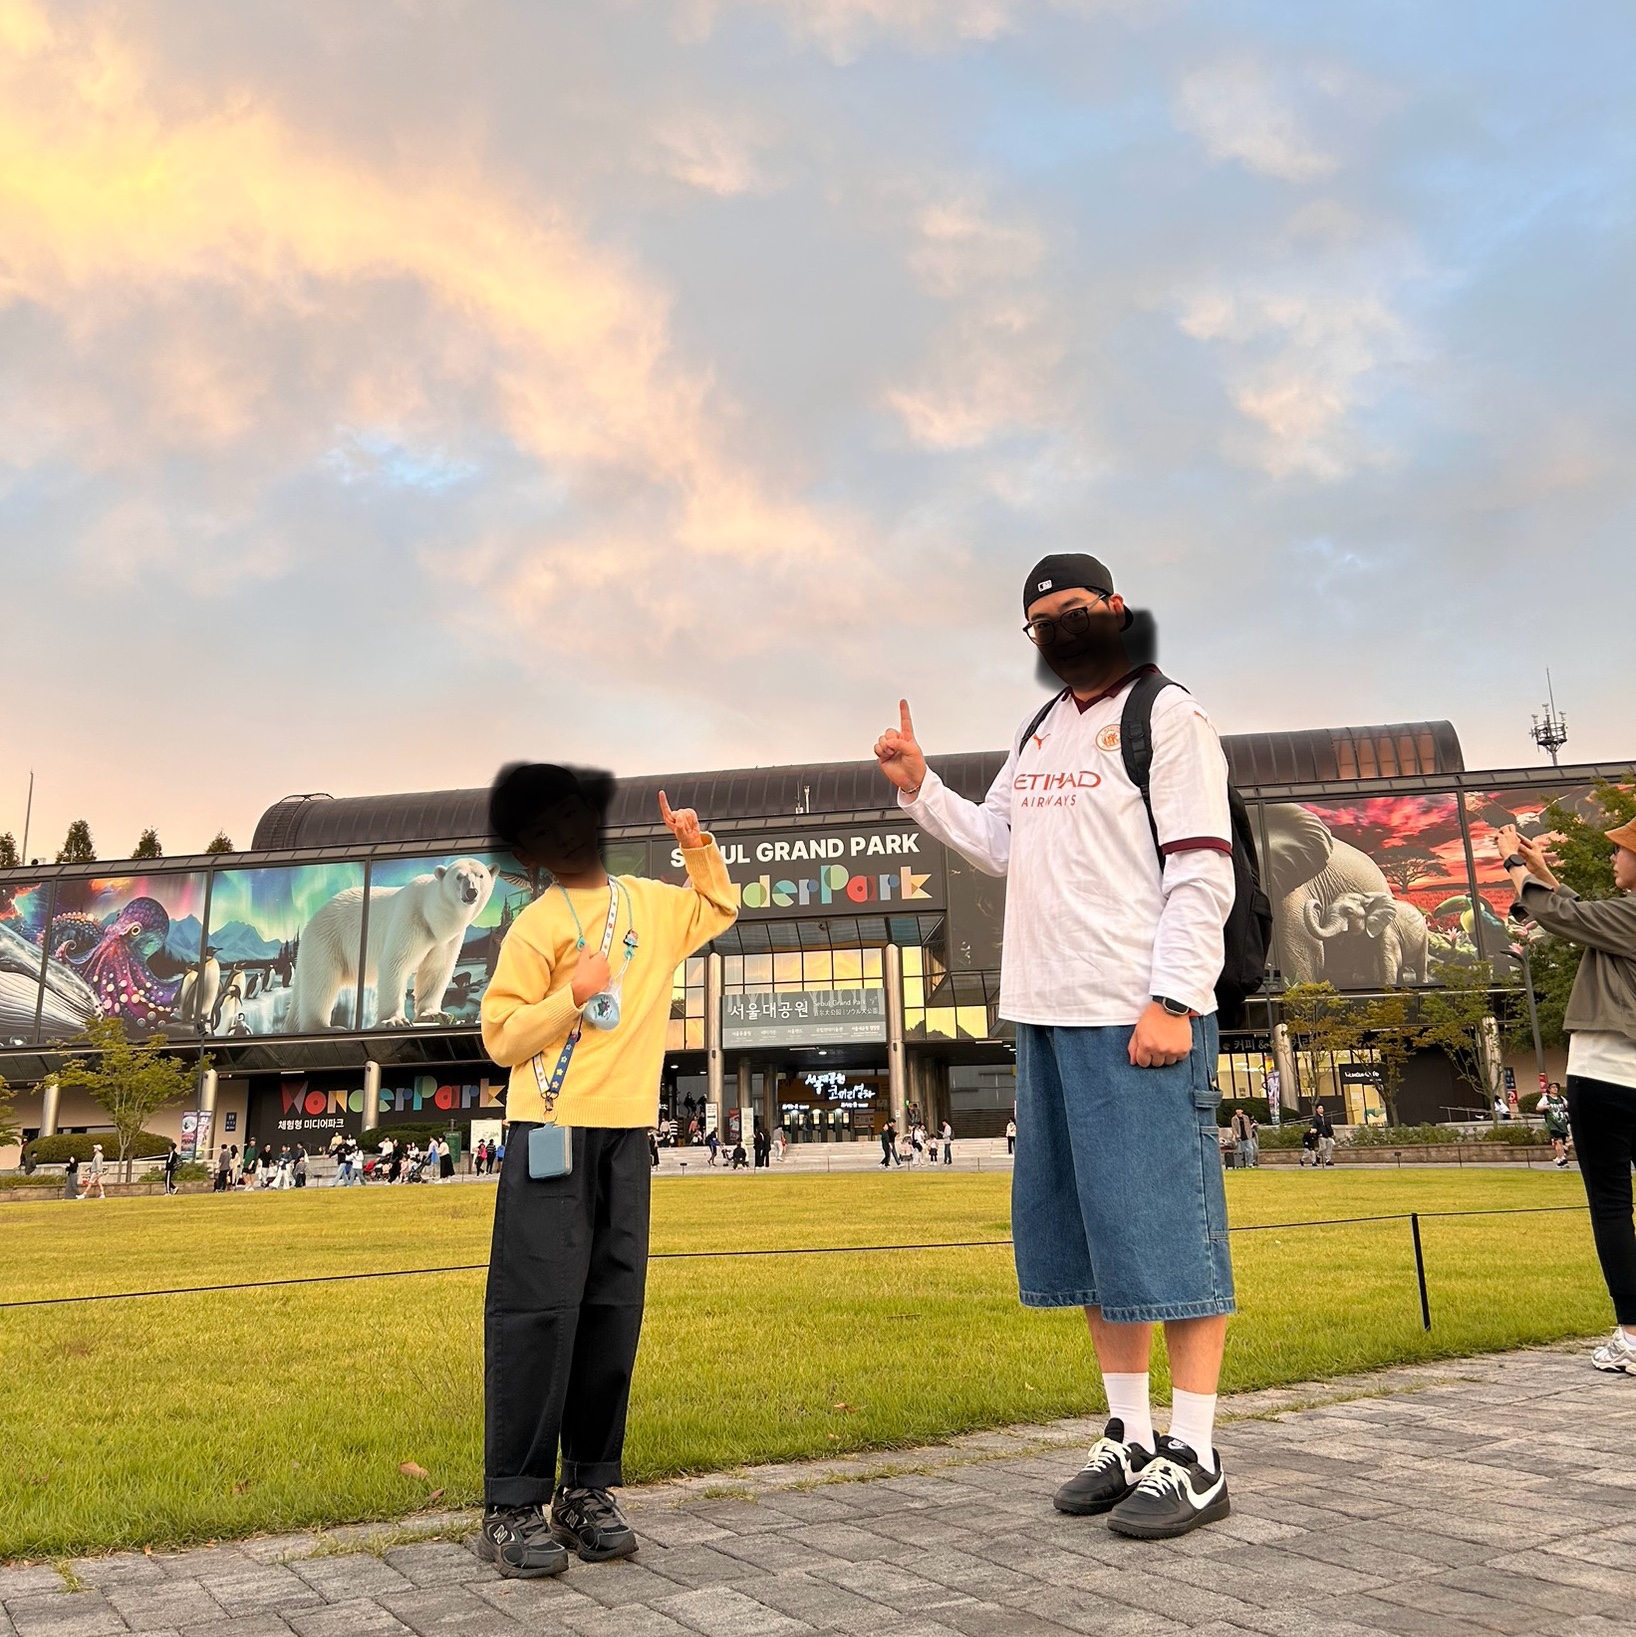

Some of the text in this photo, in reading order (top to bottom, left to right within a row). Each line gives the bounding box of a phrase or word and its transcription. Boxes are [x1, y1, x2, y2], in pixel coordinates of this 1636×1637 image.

[1013, 770, 1102, 791] ETIHAD
[1020, 794, 1077, 808] AIRWAYS
[670, 832, 921, 868] SUL GRAND PARK
[729, 1000, 809, 1020] 서울대공원
[832, 999, 851, 1007] Grand
[1233, 1039, 1256, 1051] 커피
[277, 1118, 345, 1131] 체험형 미디어파크
